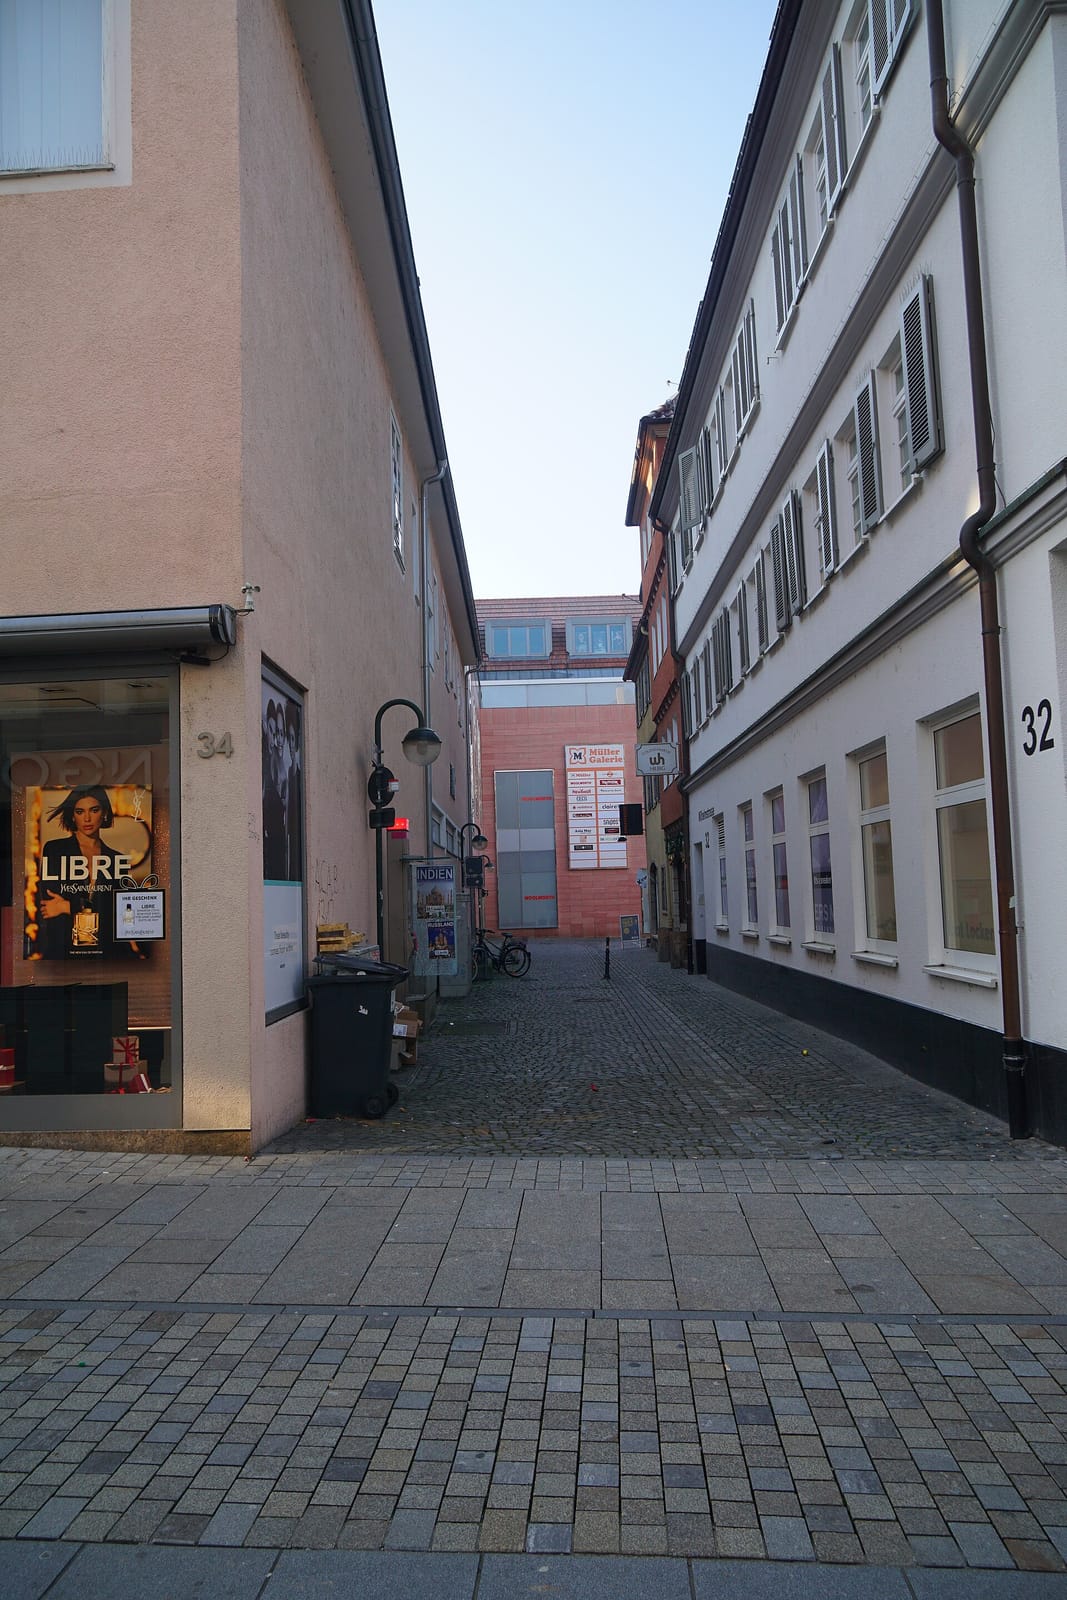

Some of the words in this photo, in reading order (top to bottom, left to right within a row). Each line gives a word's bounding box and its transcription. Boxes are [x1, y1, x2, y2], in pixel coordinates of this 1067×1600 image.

[1022, 698, 1054, 756] 32
[197, 731, 233, 759] 34
[589, 748, 620, 756] Müller
[573, 752, 582, 760] M
[41, 855, 133, 881] LIBRE
[417, 869, 453, 880] INDIEN
